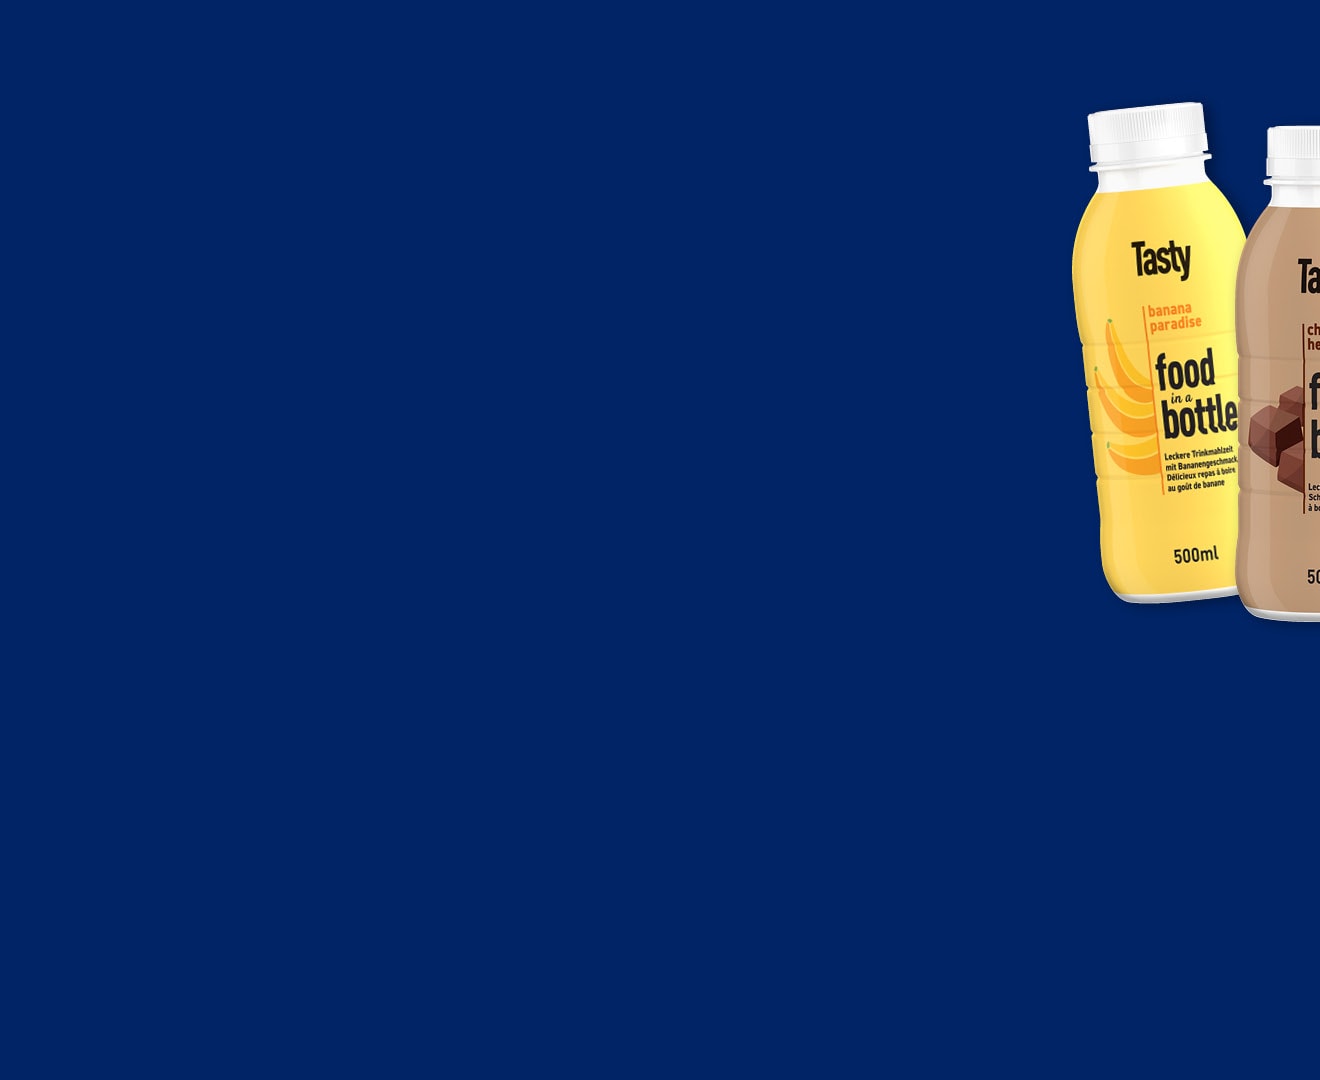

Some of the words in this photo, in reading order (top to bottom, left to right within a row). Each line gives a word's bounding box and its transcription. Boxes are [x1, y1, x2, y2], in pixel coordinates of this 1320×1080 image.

[1131, 240, 1190, 282] Tasty
[1148, 304, 1192, 317] banana
[1150, 316, 1202, 334] paradise
[1155, 347, 1215, 391] food
[1171, 393, 1182, 404] in
[1185, 394, 1193, 403] a
[1161, 393, 1238, 440] bottle
[1164, 452, 1190, 461] Leckere
[1192, 446, 1233, 458] Trinkmahlzeit
[1166, 463, 1176, 471] mit
[1167, 472, 1196, 482] Délicieux
[1198, 470, 1215, 480] repas
[1216, 467, 1221, 475] à
[1222, 466, 1236, 475] boire
[1177, 482, 1192, 493] goût
[1193, 481, 1201, 490] de
[1202, 480, 1225, 489] banane
[1308, 503, 1312, 512] à
[1173, 545, 1219, 564] 500ml
